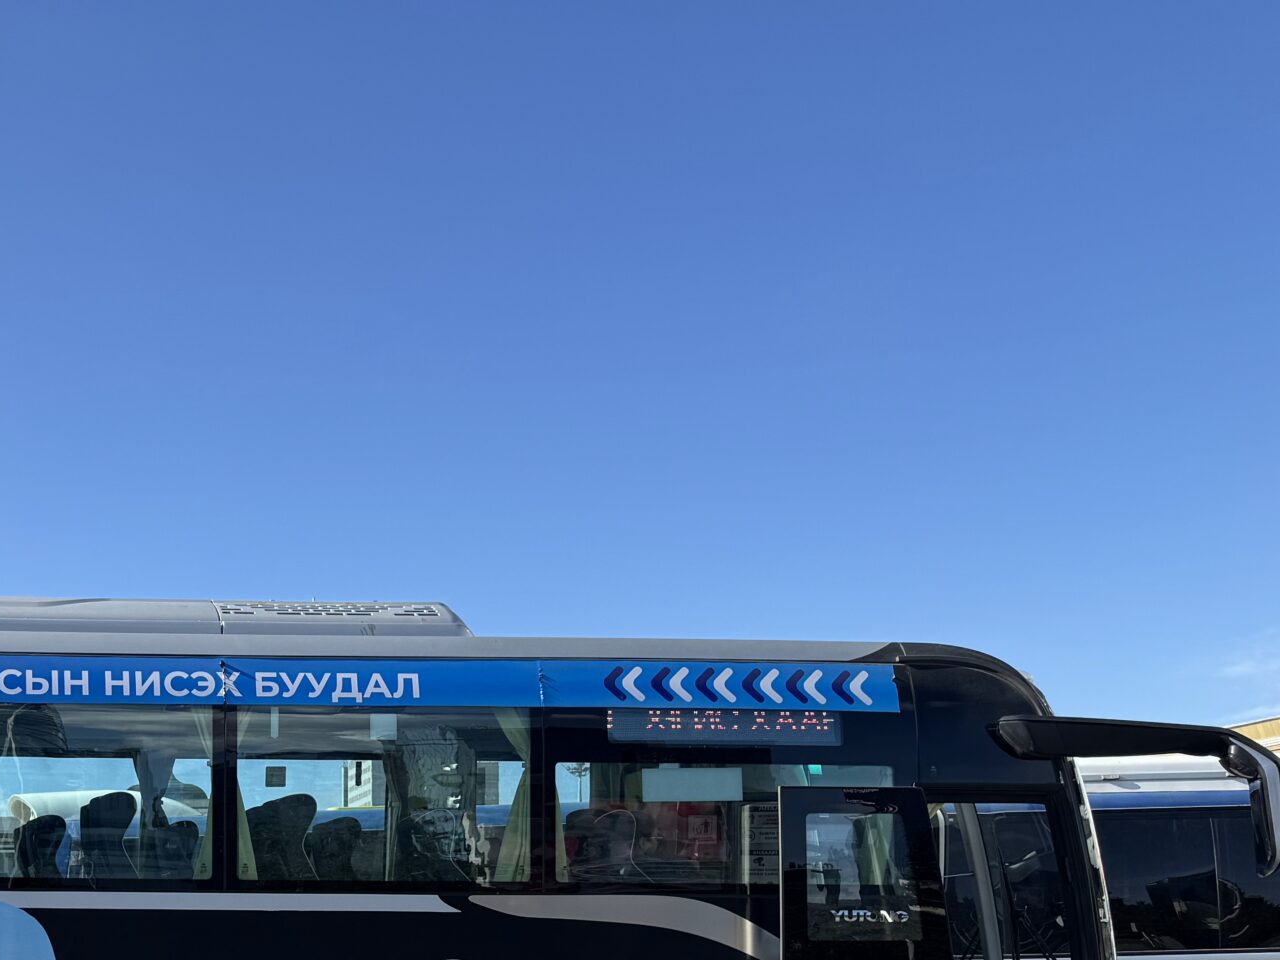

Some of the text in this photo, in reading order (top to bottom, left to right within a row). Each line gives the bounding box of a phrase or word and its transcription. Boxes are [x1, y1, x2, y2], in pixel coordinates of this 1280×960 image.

[105, 671, 241, 699] НИСЭХ
[255, 672, 421, 703] БУУДАЛ
[830, 909, 910, 923] YUTONG
